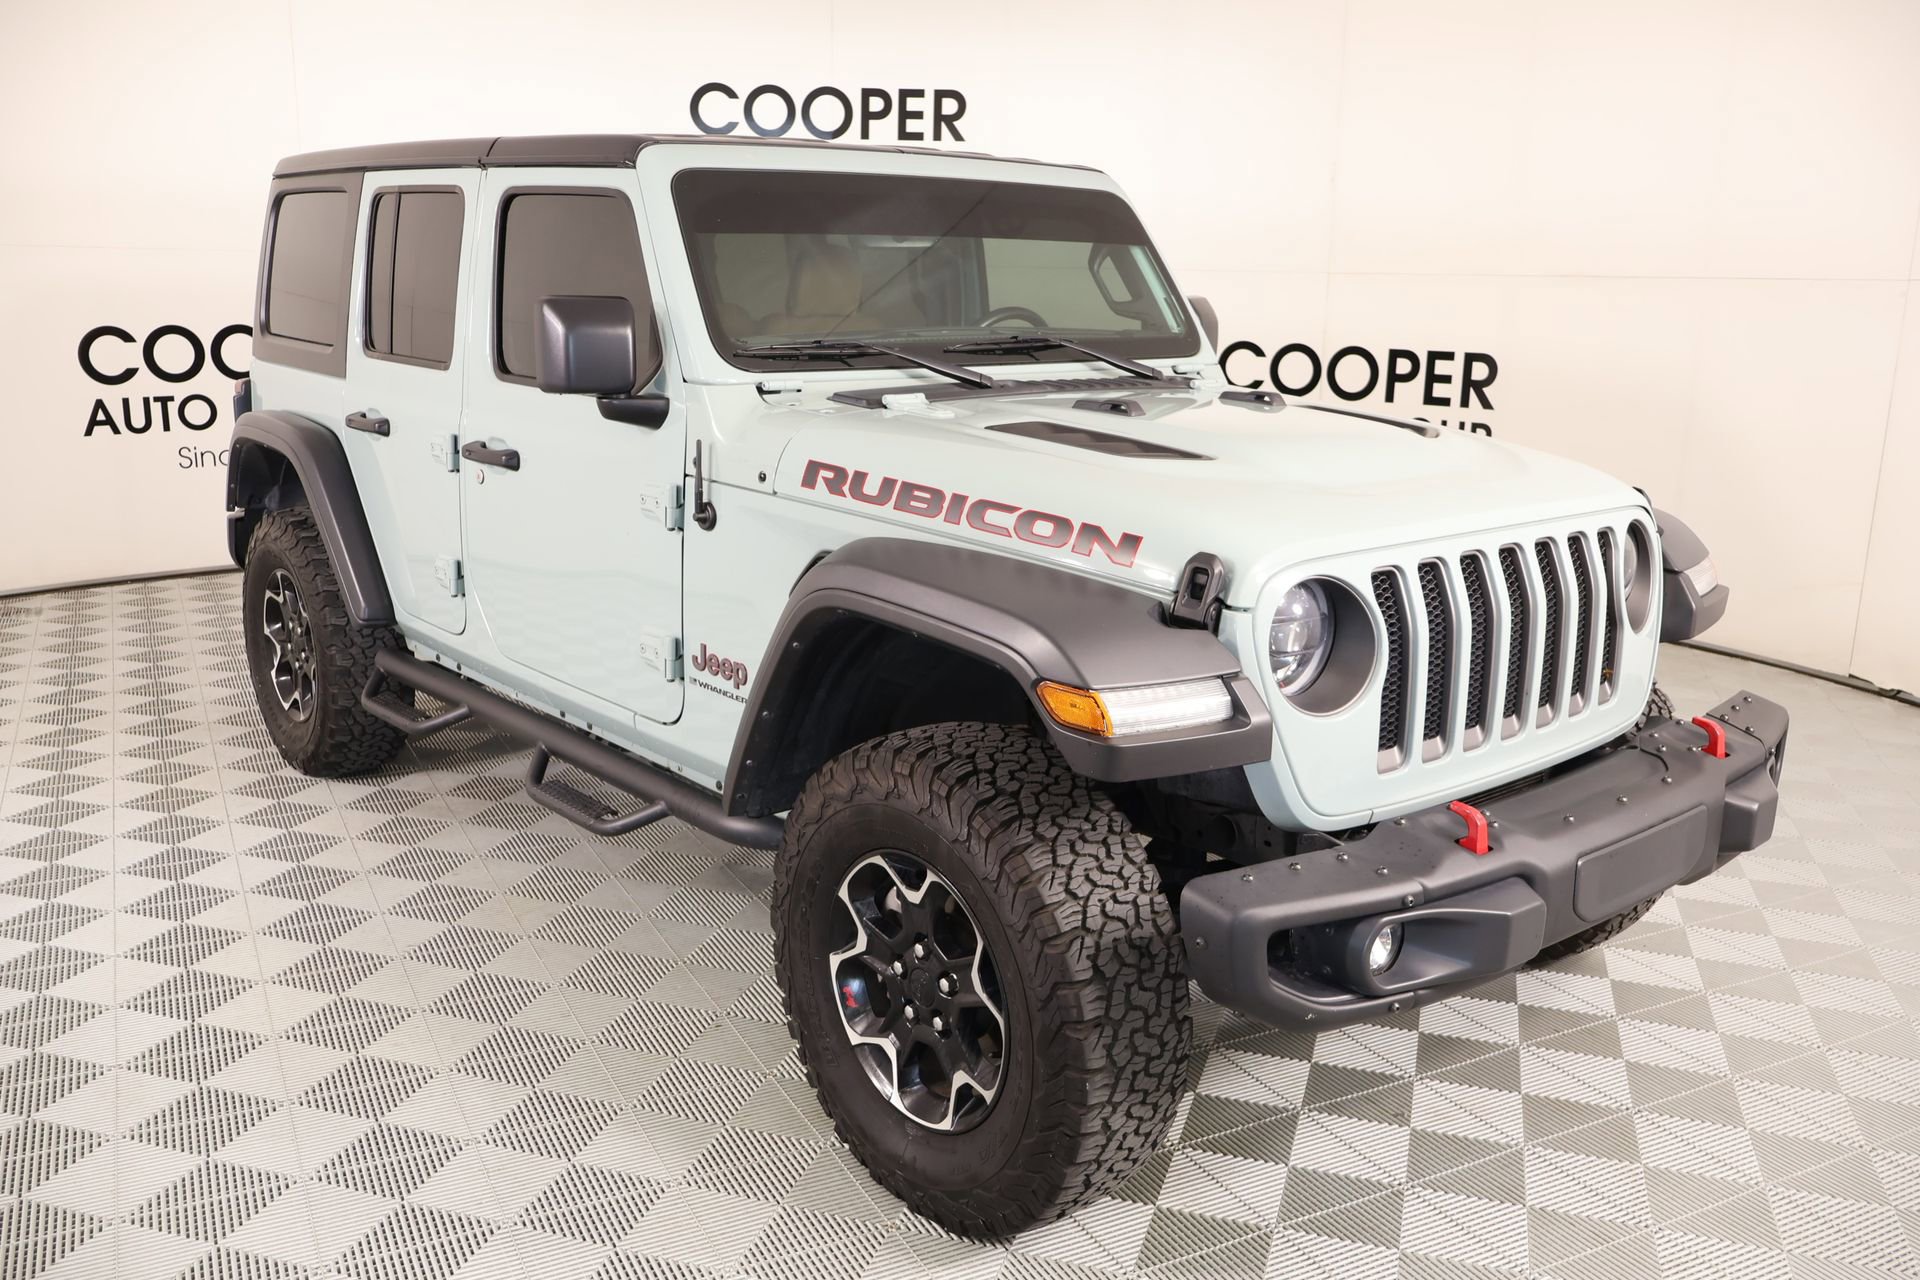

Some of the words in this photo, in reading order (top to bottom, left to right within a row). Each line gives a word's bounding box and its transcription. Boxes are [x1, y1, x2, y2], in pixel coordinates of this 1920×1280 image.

[690, 82, 967, 142] COOPER
[1218, 340, 1498, 410] COOPER
[84, 394, 217, 436] AUTO
[800, 459, 1144, 568] RUBICON
[691, 643, 748, 690] Jeep
